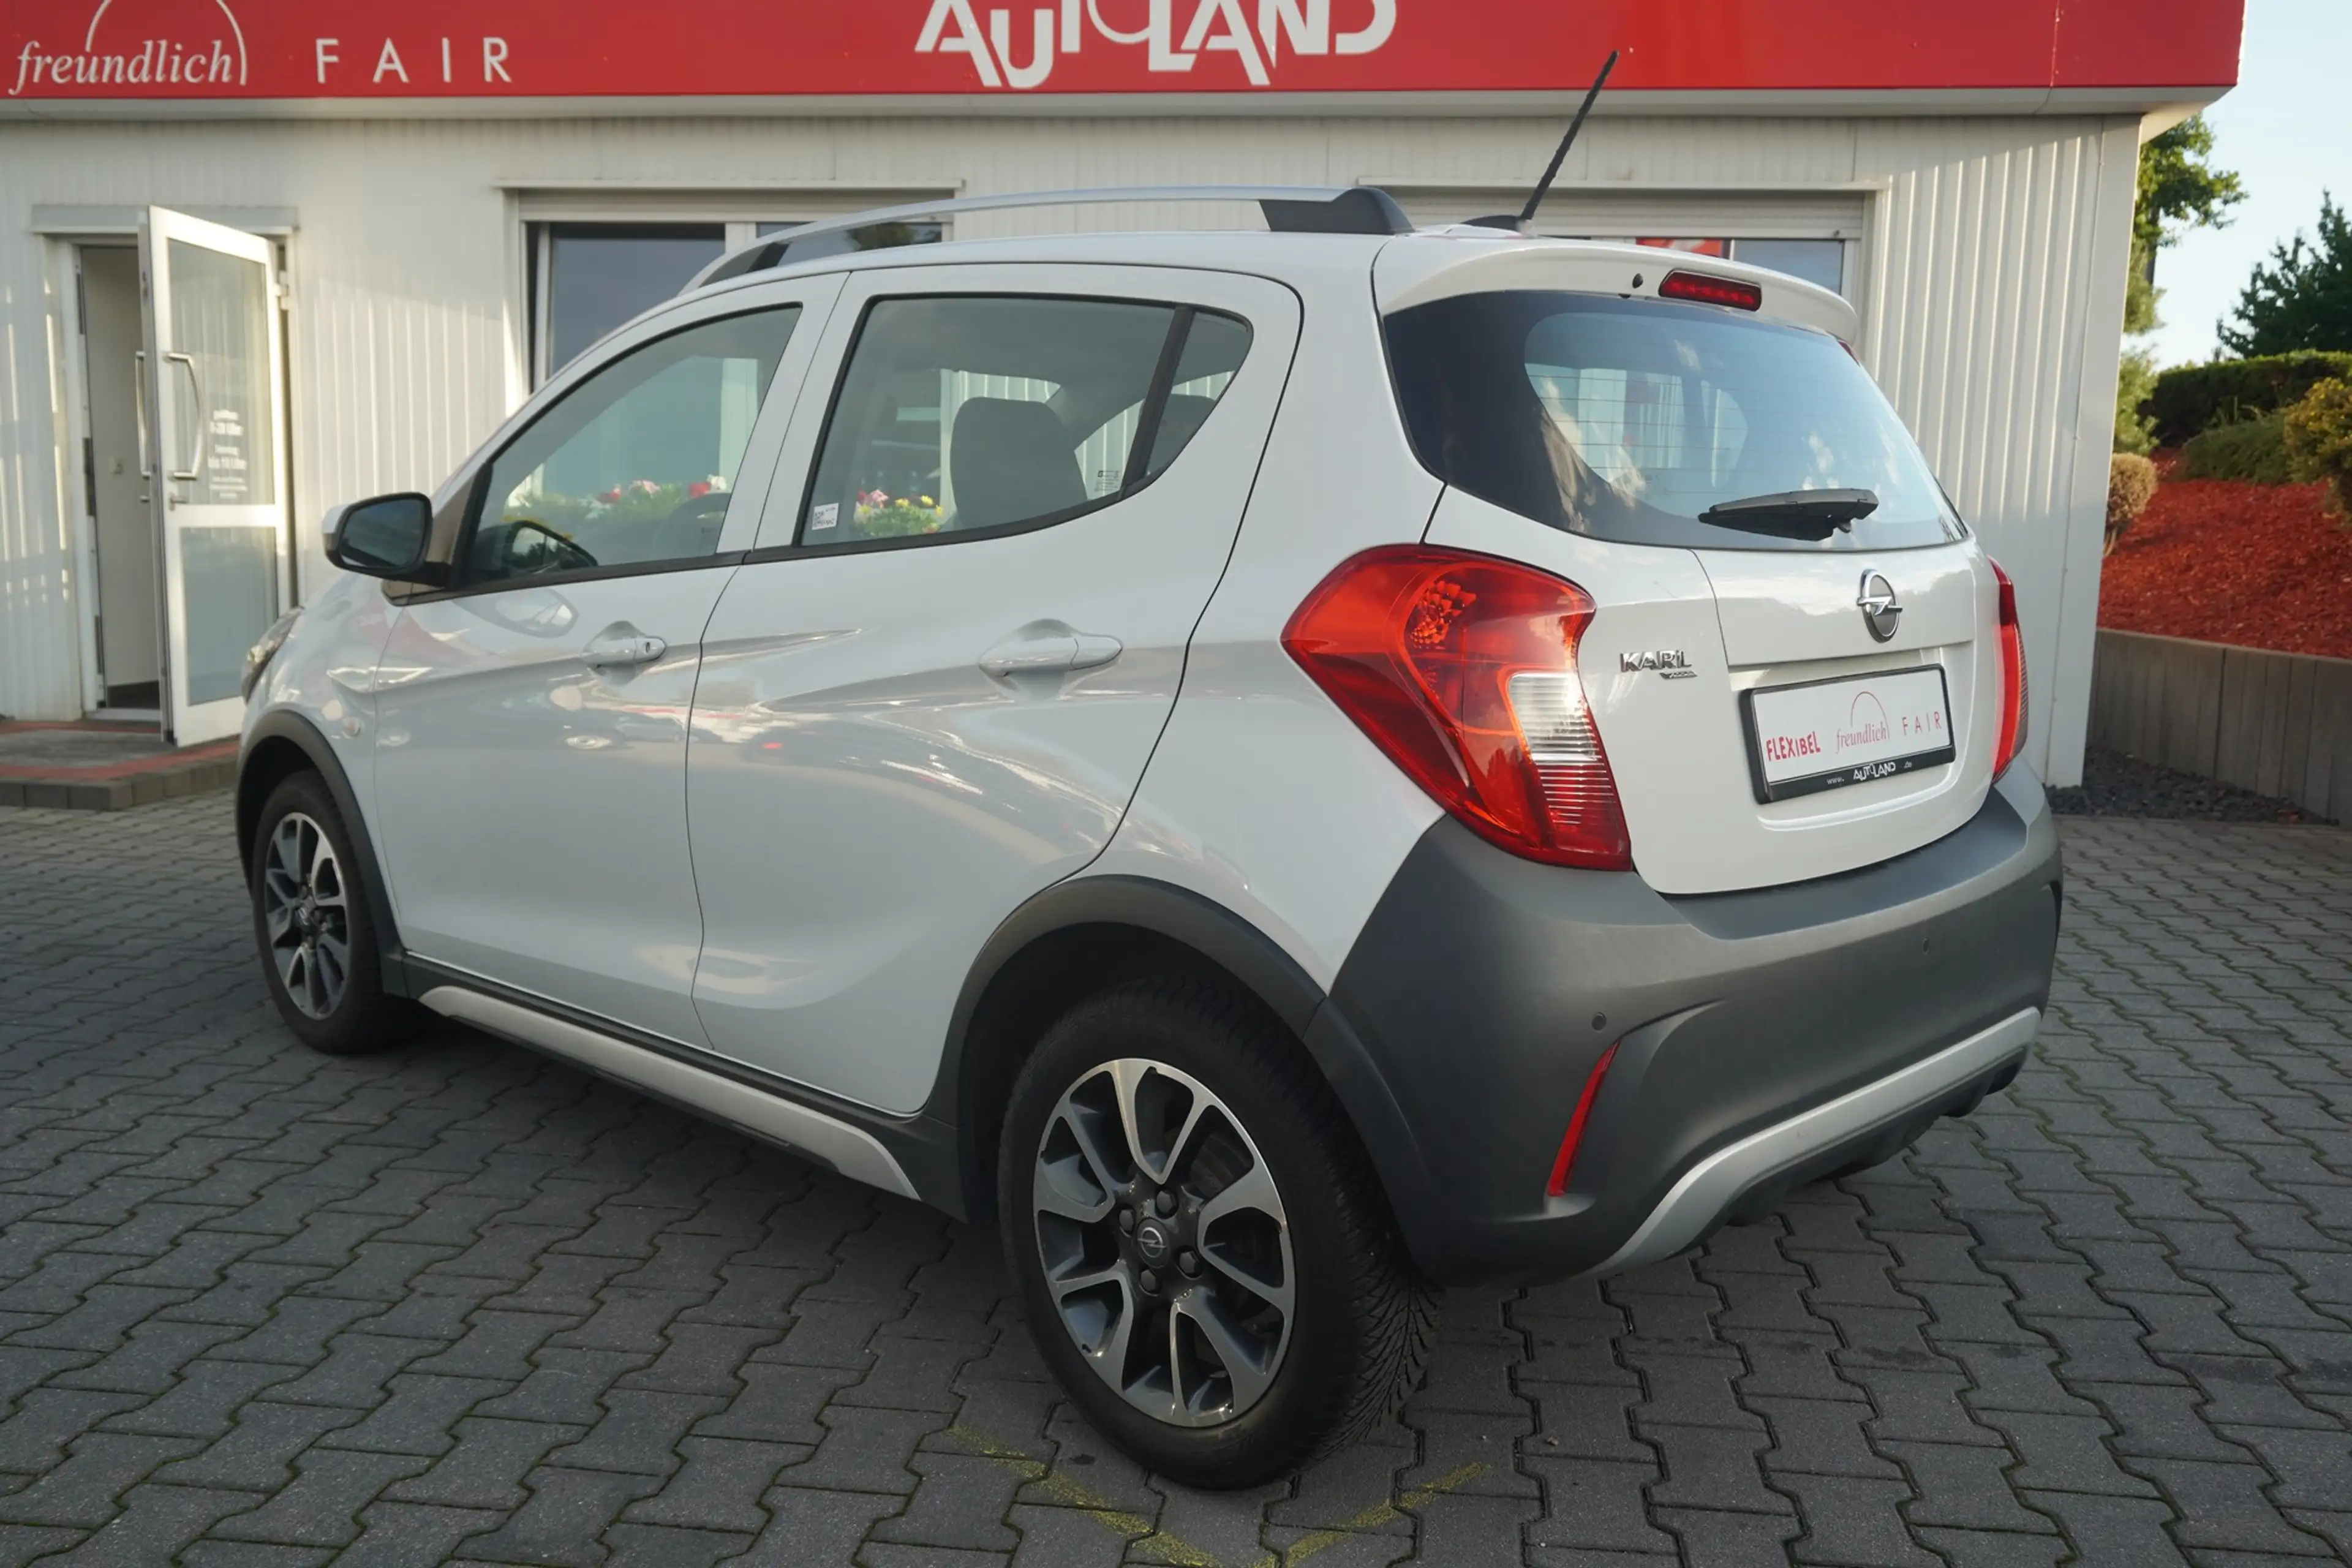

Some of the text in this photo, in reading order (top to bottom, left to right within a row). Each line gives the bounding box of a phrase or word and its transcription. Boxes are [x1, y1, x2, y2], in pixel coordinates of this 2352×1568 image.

[8, 37, 512, 95] freundlich FAIR
[1619, 650, 1692, 673] KARL
[1766, 711, 1942, 761] FLEXIBEL freundlich FAIR
[1853, 761, 1896, 782] AUTOLAND
